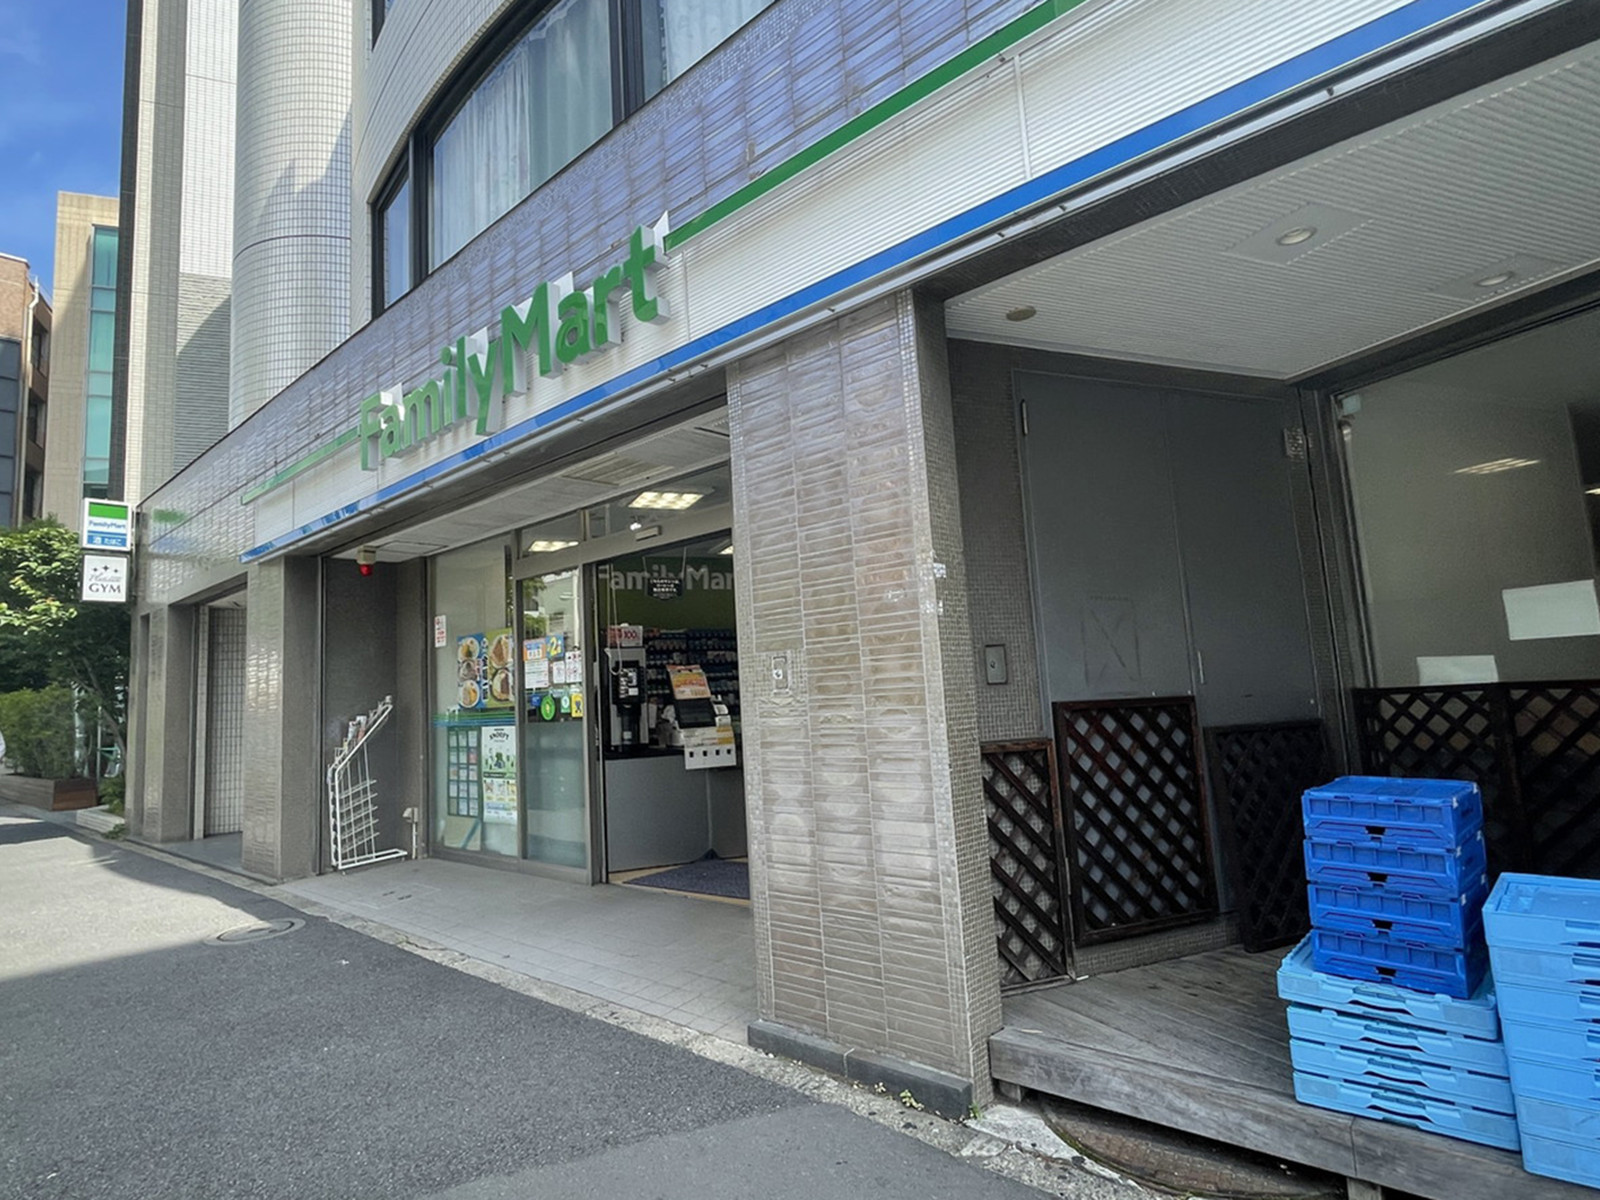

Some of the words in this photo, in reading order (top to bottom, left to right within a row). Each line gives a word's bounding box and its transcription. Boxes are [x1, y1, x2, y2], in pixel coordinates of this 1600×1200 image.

[360, 224, 669, 471] FamilyMart
[88, 519, 126, 529] FamilyMart
[88, 583, 122, 594] GYM
